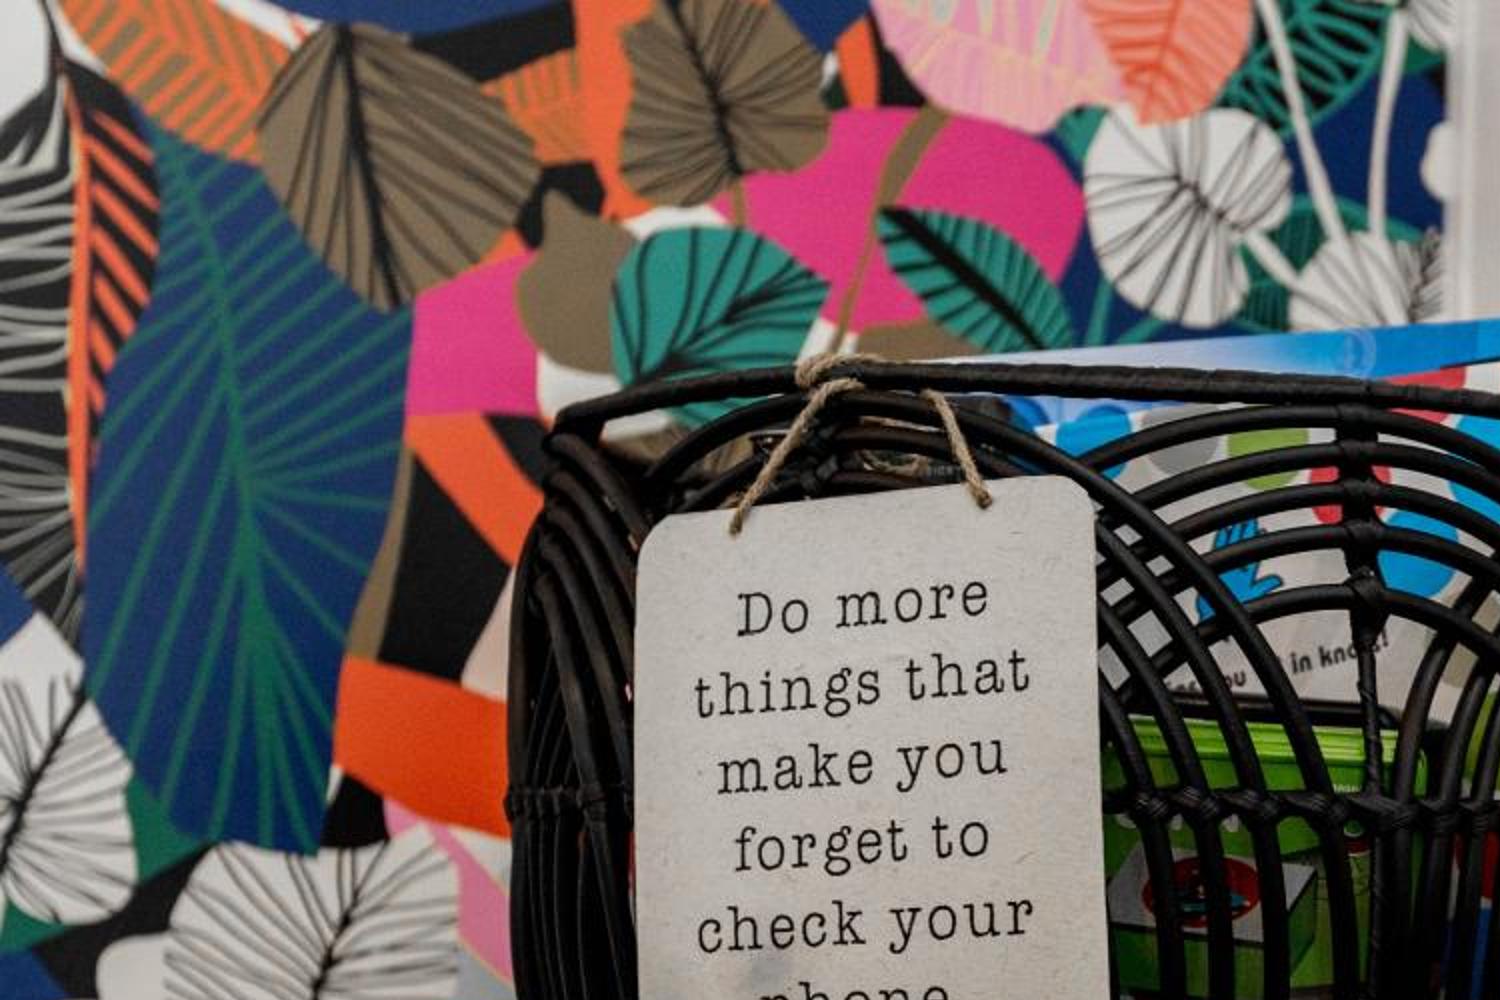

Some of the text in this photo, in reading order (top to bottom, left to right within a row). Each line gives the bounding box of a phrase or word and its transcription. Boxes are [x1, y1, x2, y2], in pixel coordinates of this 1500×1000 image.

[736, 580, 989, 637] Do more
[694, 648, 1031, 718] things that
[1290, 651, 1313, 674] in
[716, 738, 1009, 795] make you
[734, 816, 990, 877] forget to
[698, 898, 1034, 955] check your
